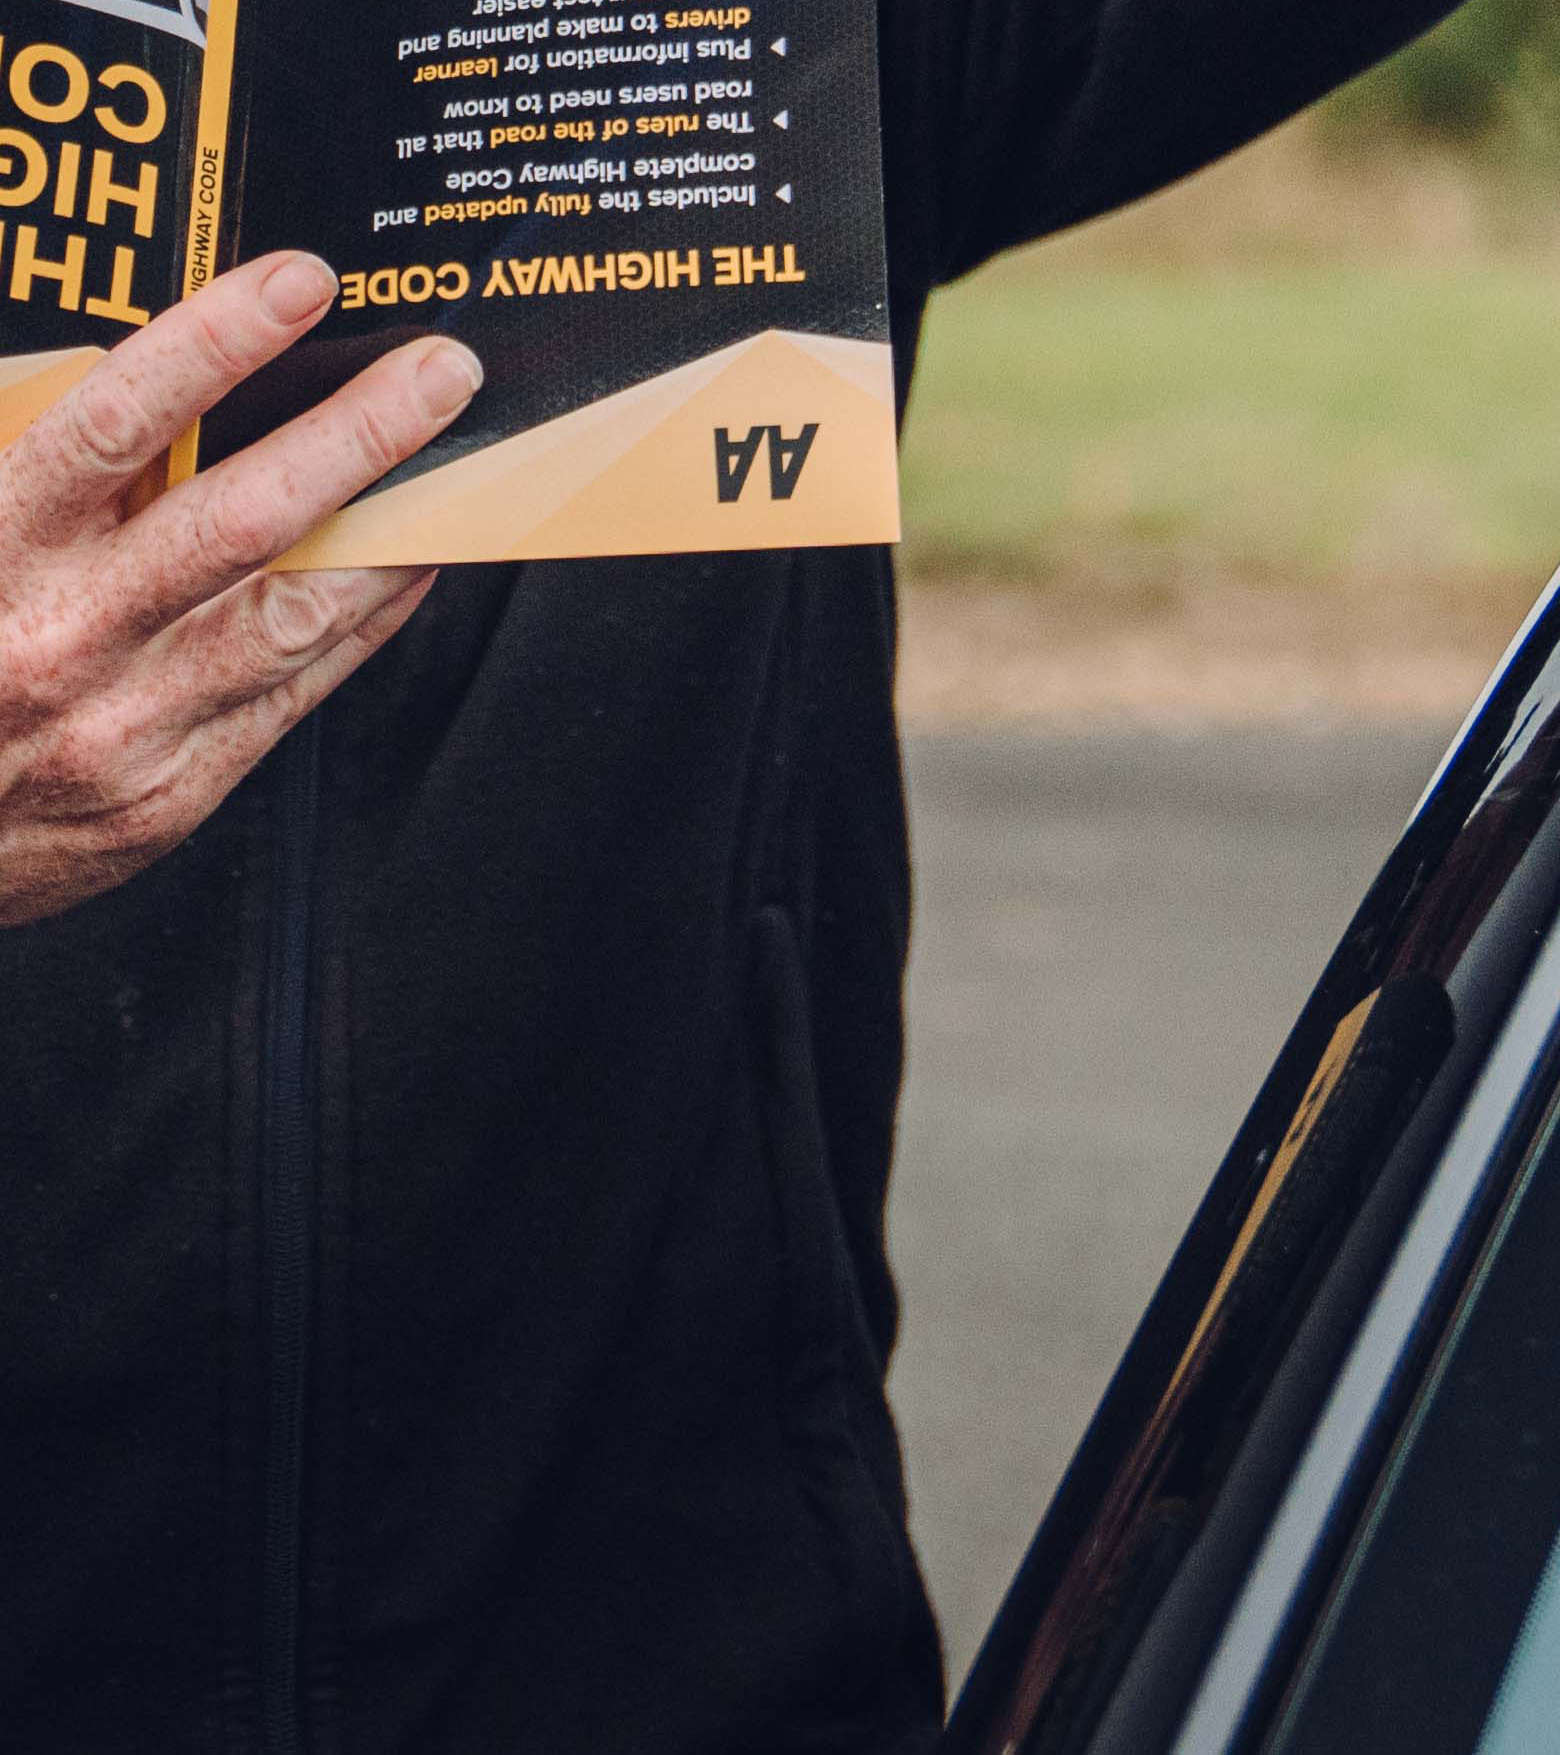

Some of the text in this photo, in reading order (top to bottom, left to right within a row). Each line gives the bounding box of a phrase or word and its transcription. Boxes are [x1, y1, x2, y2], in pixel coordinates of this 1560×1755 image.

[397, 7, 751, 60] drivers to make planning and
[413, 38, 751, 85] Plus information for learner
[443, 80, 752, 122] road users need to know
[396, 111, 753, 158] The rules of the road that all
[199, 147, 218, 204] CODE
[446, 150, 755, 193] complete Highway Code
[373, 184, 756, 231] Includes the fully updated and
[340, 244, 805, 309] THE HIGHWAY CODE
[712, 422, 819, 503] AA
